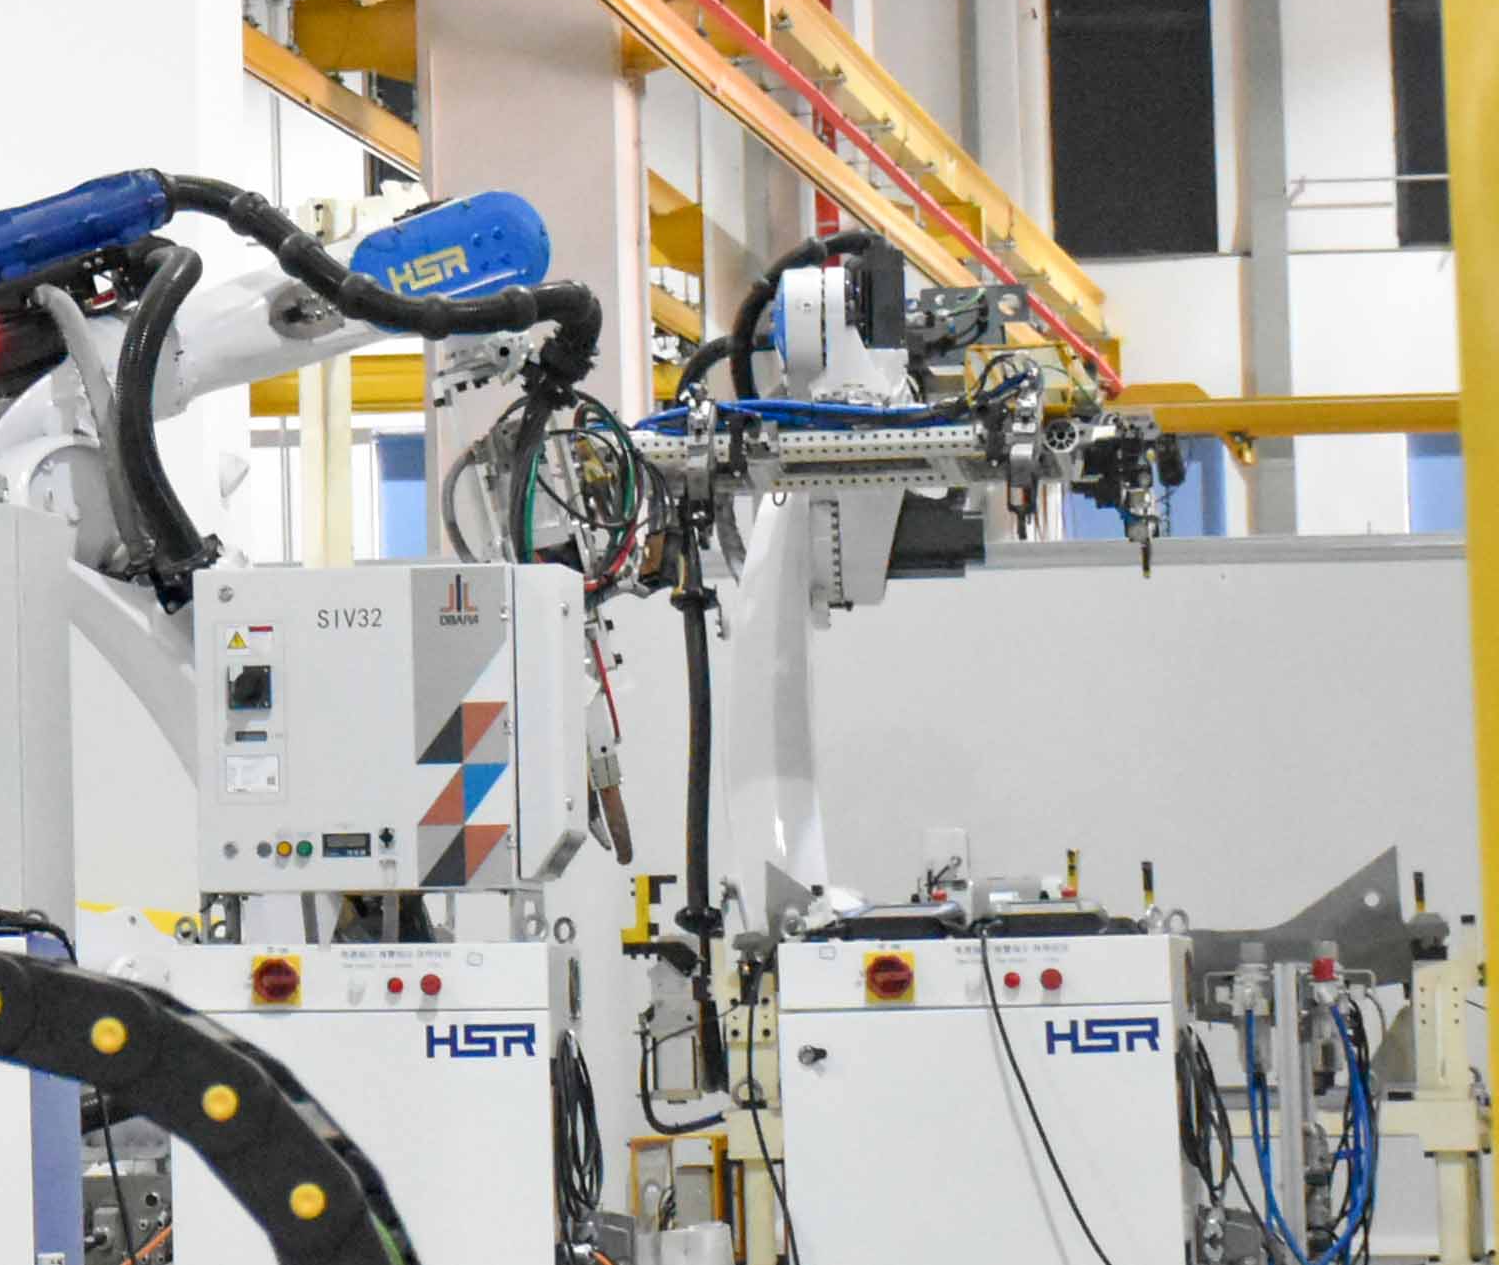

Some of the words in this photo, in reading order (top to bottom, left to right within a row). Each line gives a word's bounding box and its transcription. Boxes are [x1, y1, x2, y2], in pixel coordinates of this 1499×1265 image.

[386, 244, 470, 296] HSR
[316, 608, 383, 630] SIV32
[425, 1023, 536, 1059] HSR
[1044, 1016, 1161, 1055] HSR
